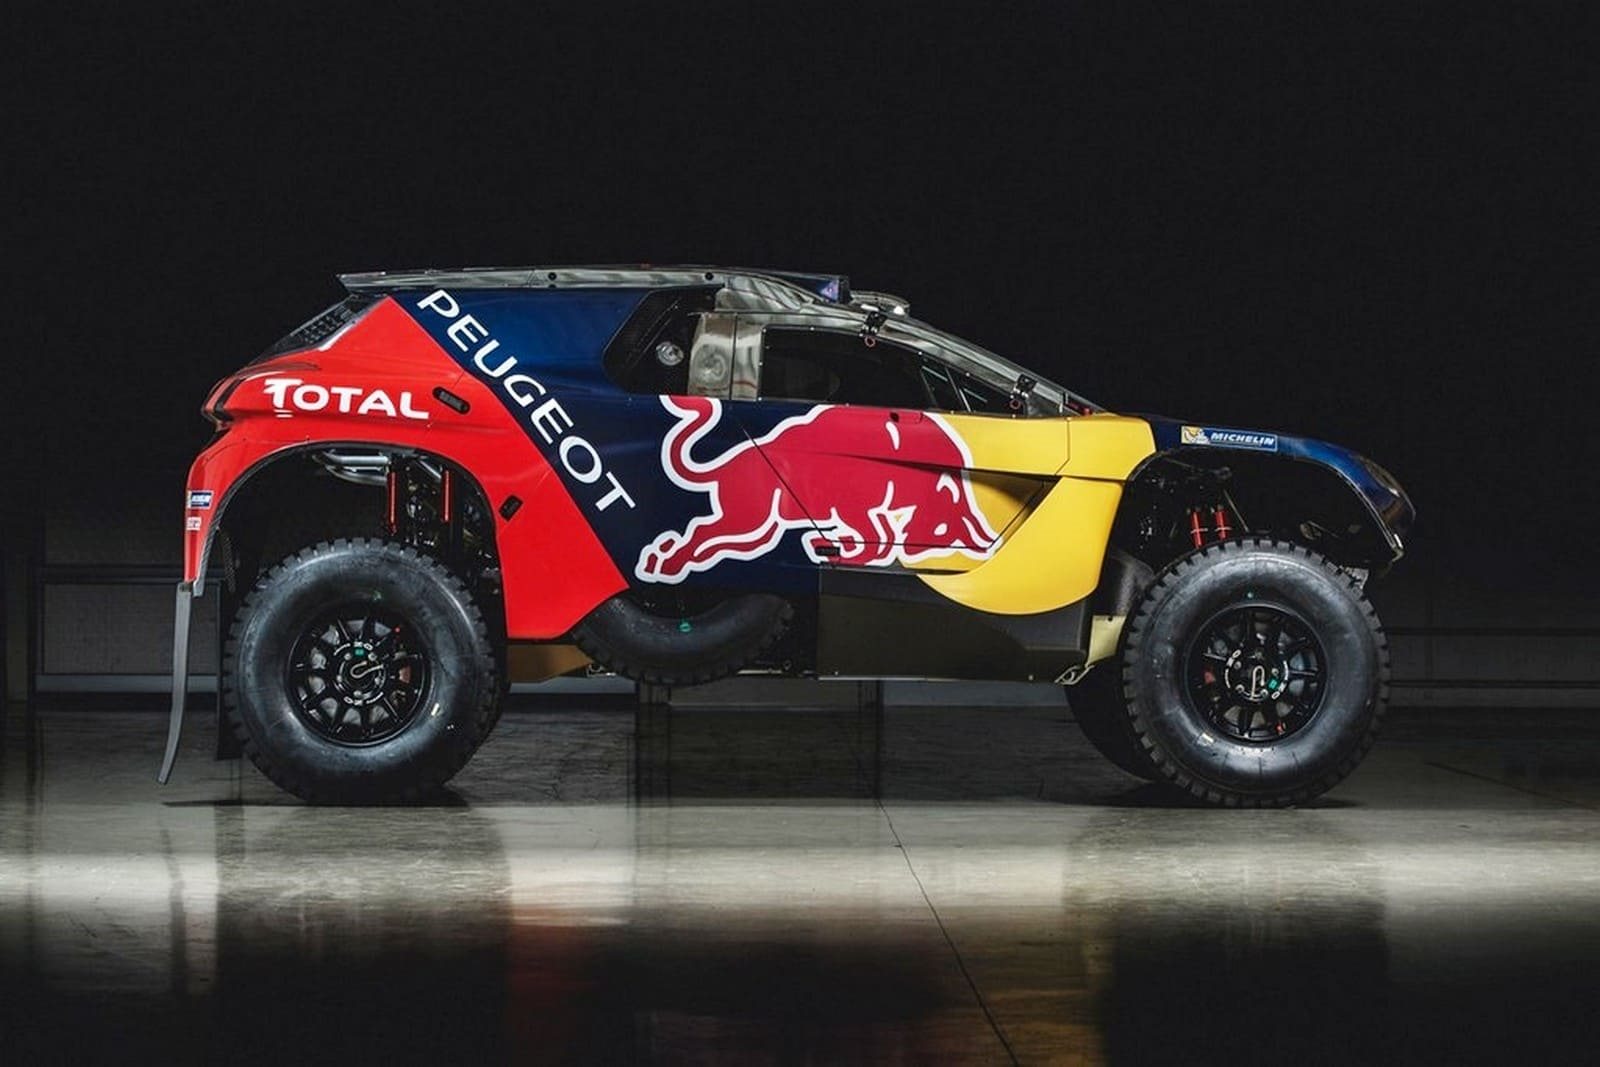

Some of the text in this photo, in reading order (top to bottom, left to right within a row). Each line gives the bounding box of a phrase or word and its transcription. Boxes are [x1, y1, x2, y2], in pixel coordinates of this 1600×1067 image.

[263, 378, 429, 420] TOTAL
[417, 289, 636, 511] PEUGEOT
[1210, 432, 1275, 446] MICHELIN
